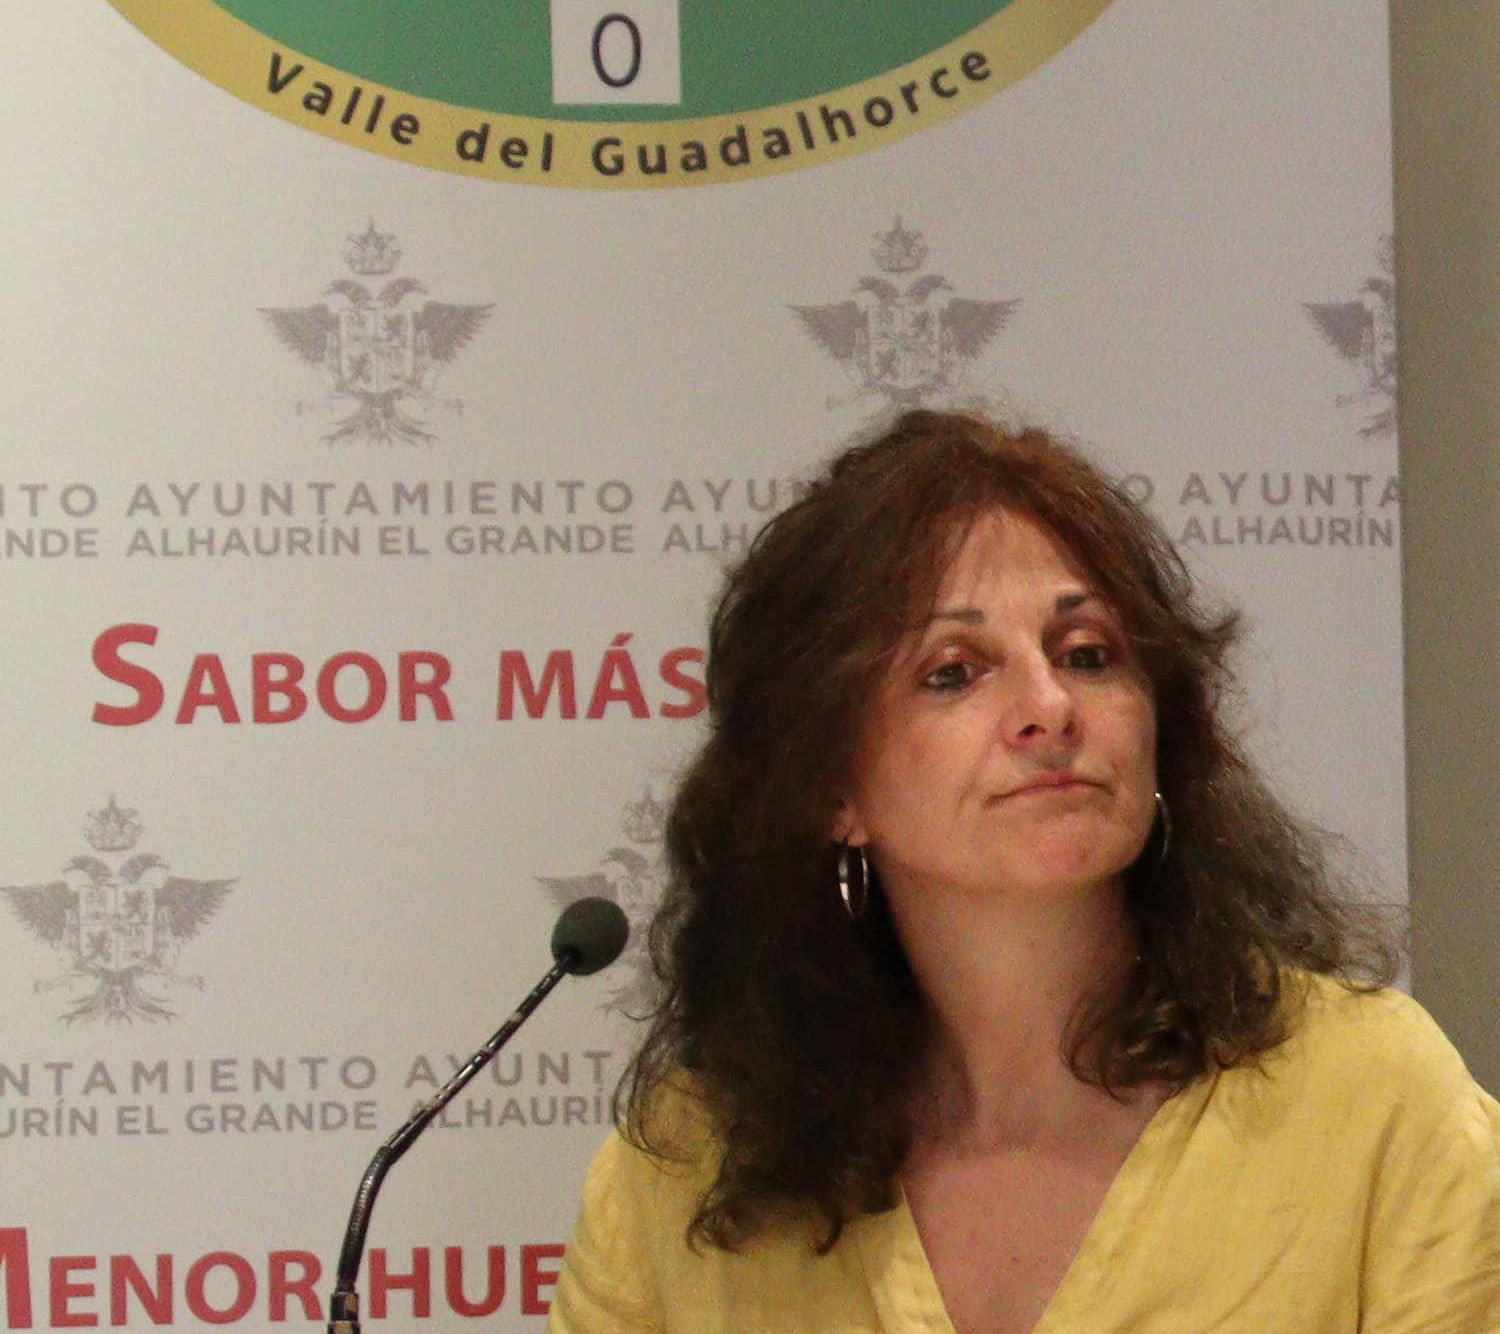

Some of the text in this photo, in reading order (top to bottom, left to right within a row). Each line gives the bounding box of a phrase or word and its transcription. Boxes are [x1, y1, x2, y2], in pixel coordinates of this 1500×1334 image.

[267, 50, 992, 176] Valle del Guadalhorce
[125, 480, 633, 518] AYUNTAMIENTO
[125, 519, 361, 558] ALHAURÍN
[378, 525, 430, 556] EL
[445, 524, 635, 556] GRANDE
[1179, 509, 1394, 547] ALHAURÍN
[91, 623, 709, 727] SABOR MÁS
[117, 1105, 169, 1135] EL
[185, 1101, 377, 1134] GRANDE
